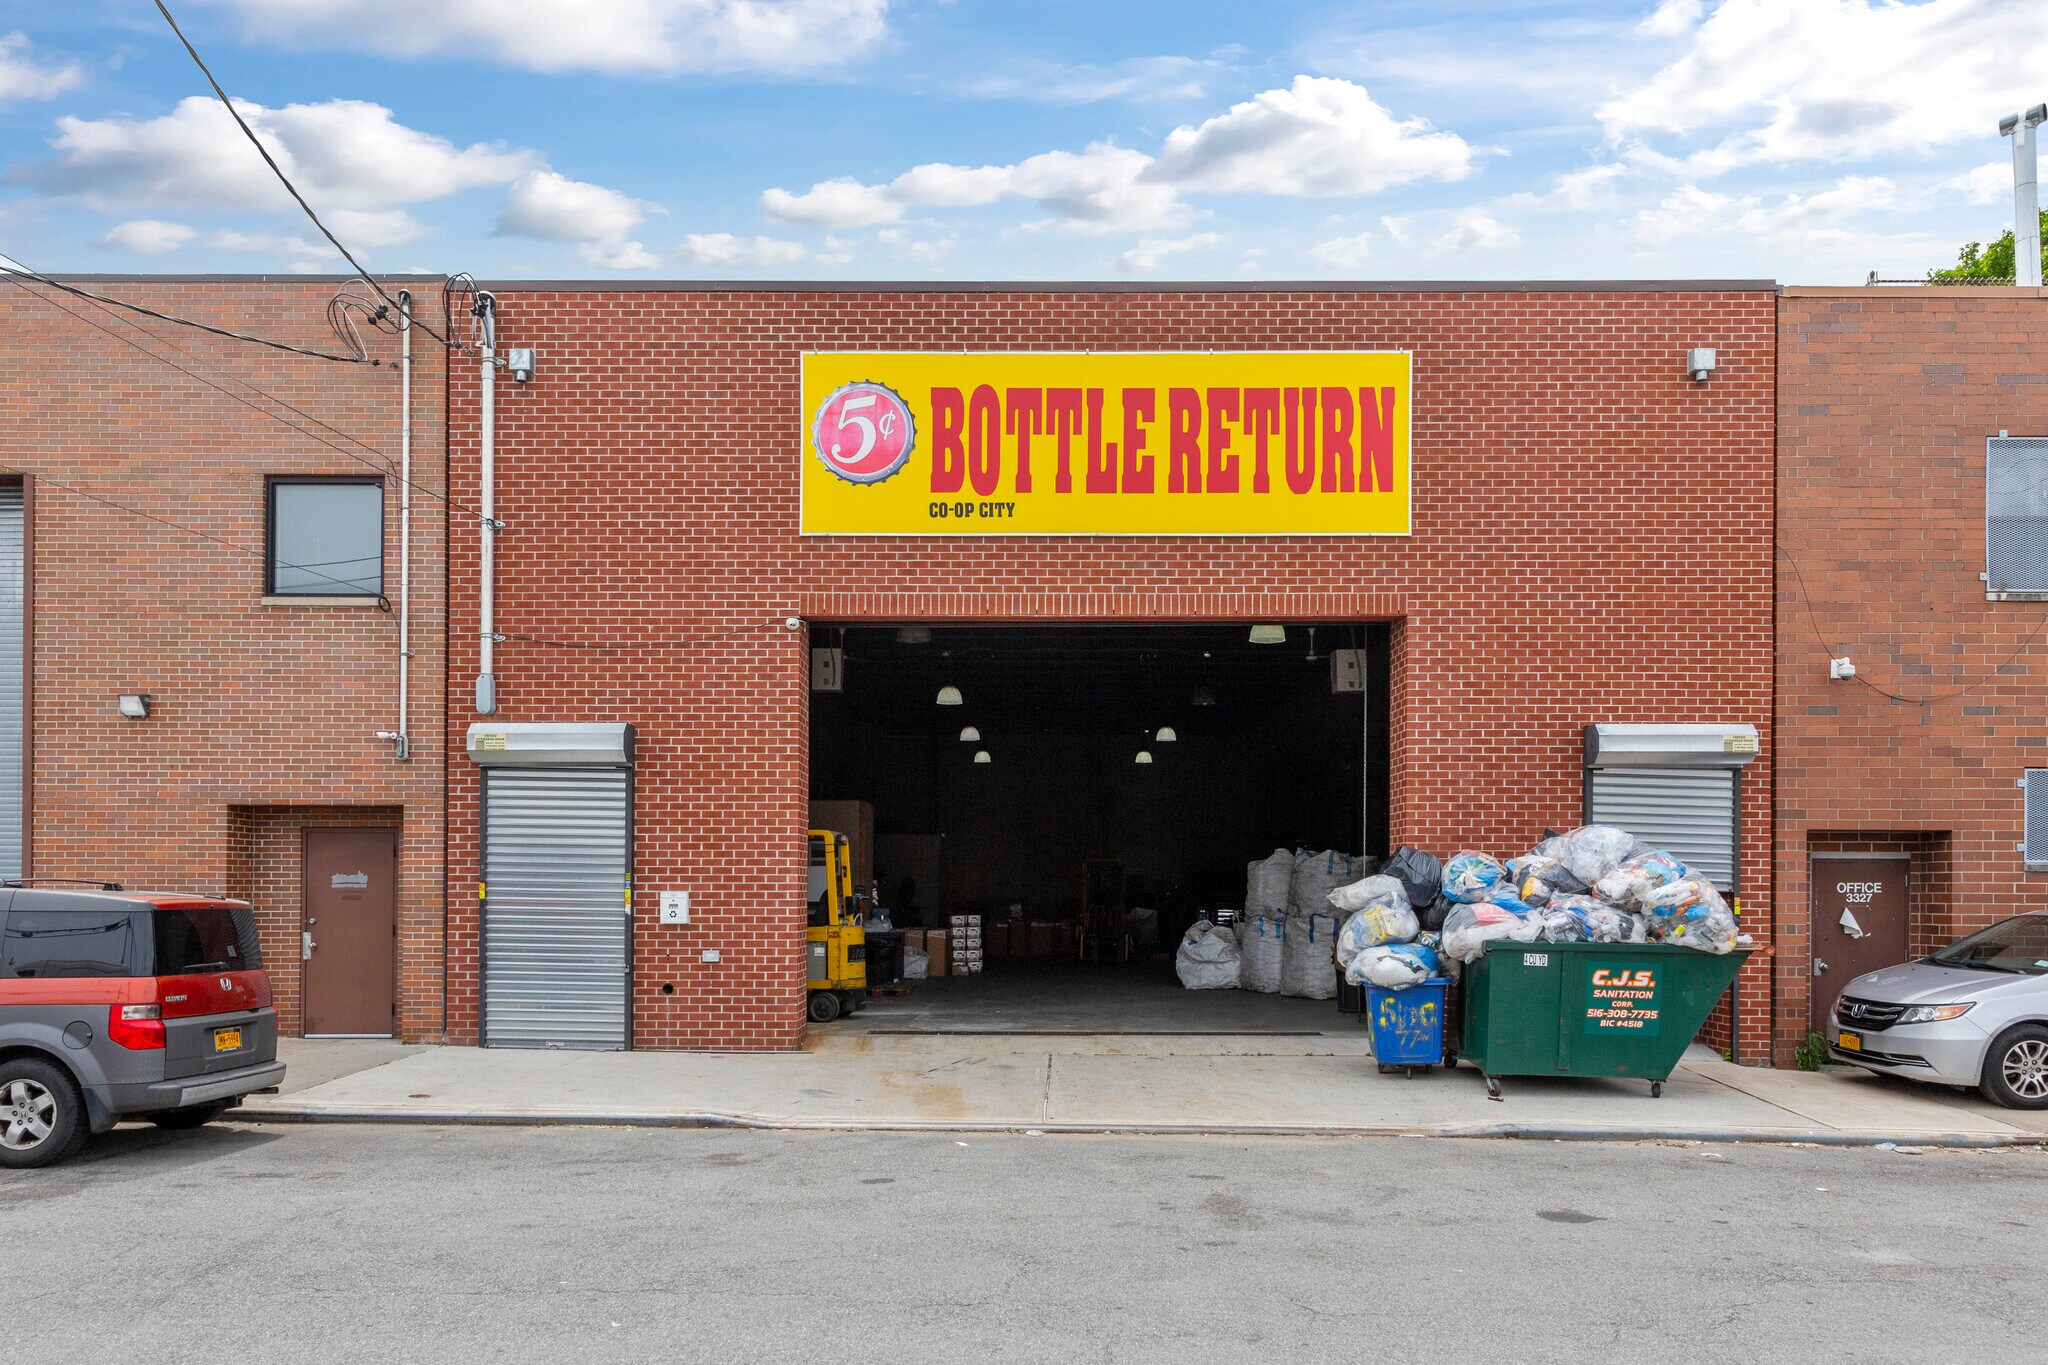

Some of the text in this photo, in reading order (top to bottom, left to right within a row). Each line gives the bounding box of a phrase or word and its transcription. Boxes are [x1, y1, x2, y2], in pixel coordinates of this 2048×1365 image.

[930, 383, 1396, 497] BOTTLE RETURN
[929, 502, 1016, 519] CO-OP CITY
[1836, 882, 1883, 894] OFFICE
[1845, 893, 1873, 903] 3327
[1528, 954, 1536, 965] CU
[1538, 955, 1546, 966] YD
[1591, 969, 1656, 988] C.J.S.
[1593, 989, 1654, 999] SANITATION
[1611, 1000, 1634, 1008] CORP.
[1586, 1008, 1659, 1019] 516-308-7735
[1599, 1019, 1644, 1028] BIC #4518
